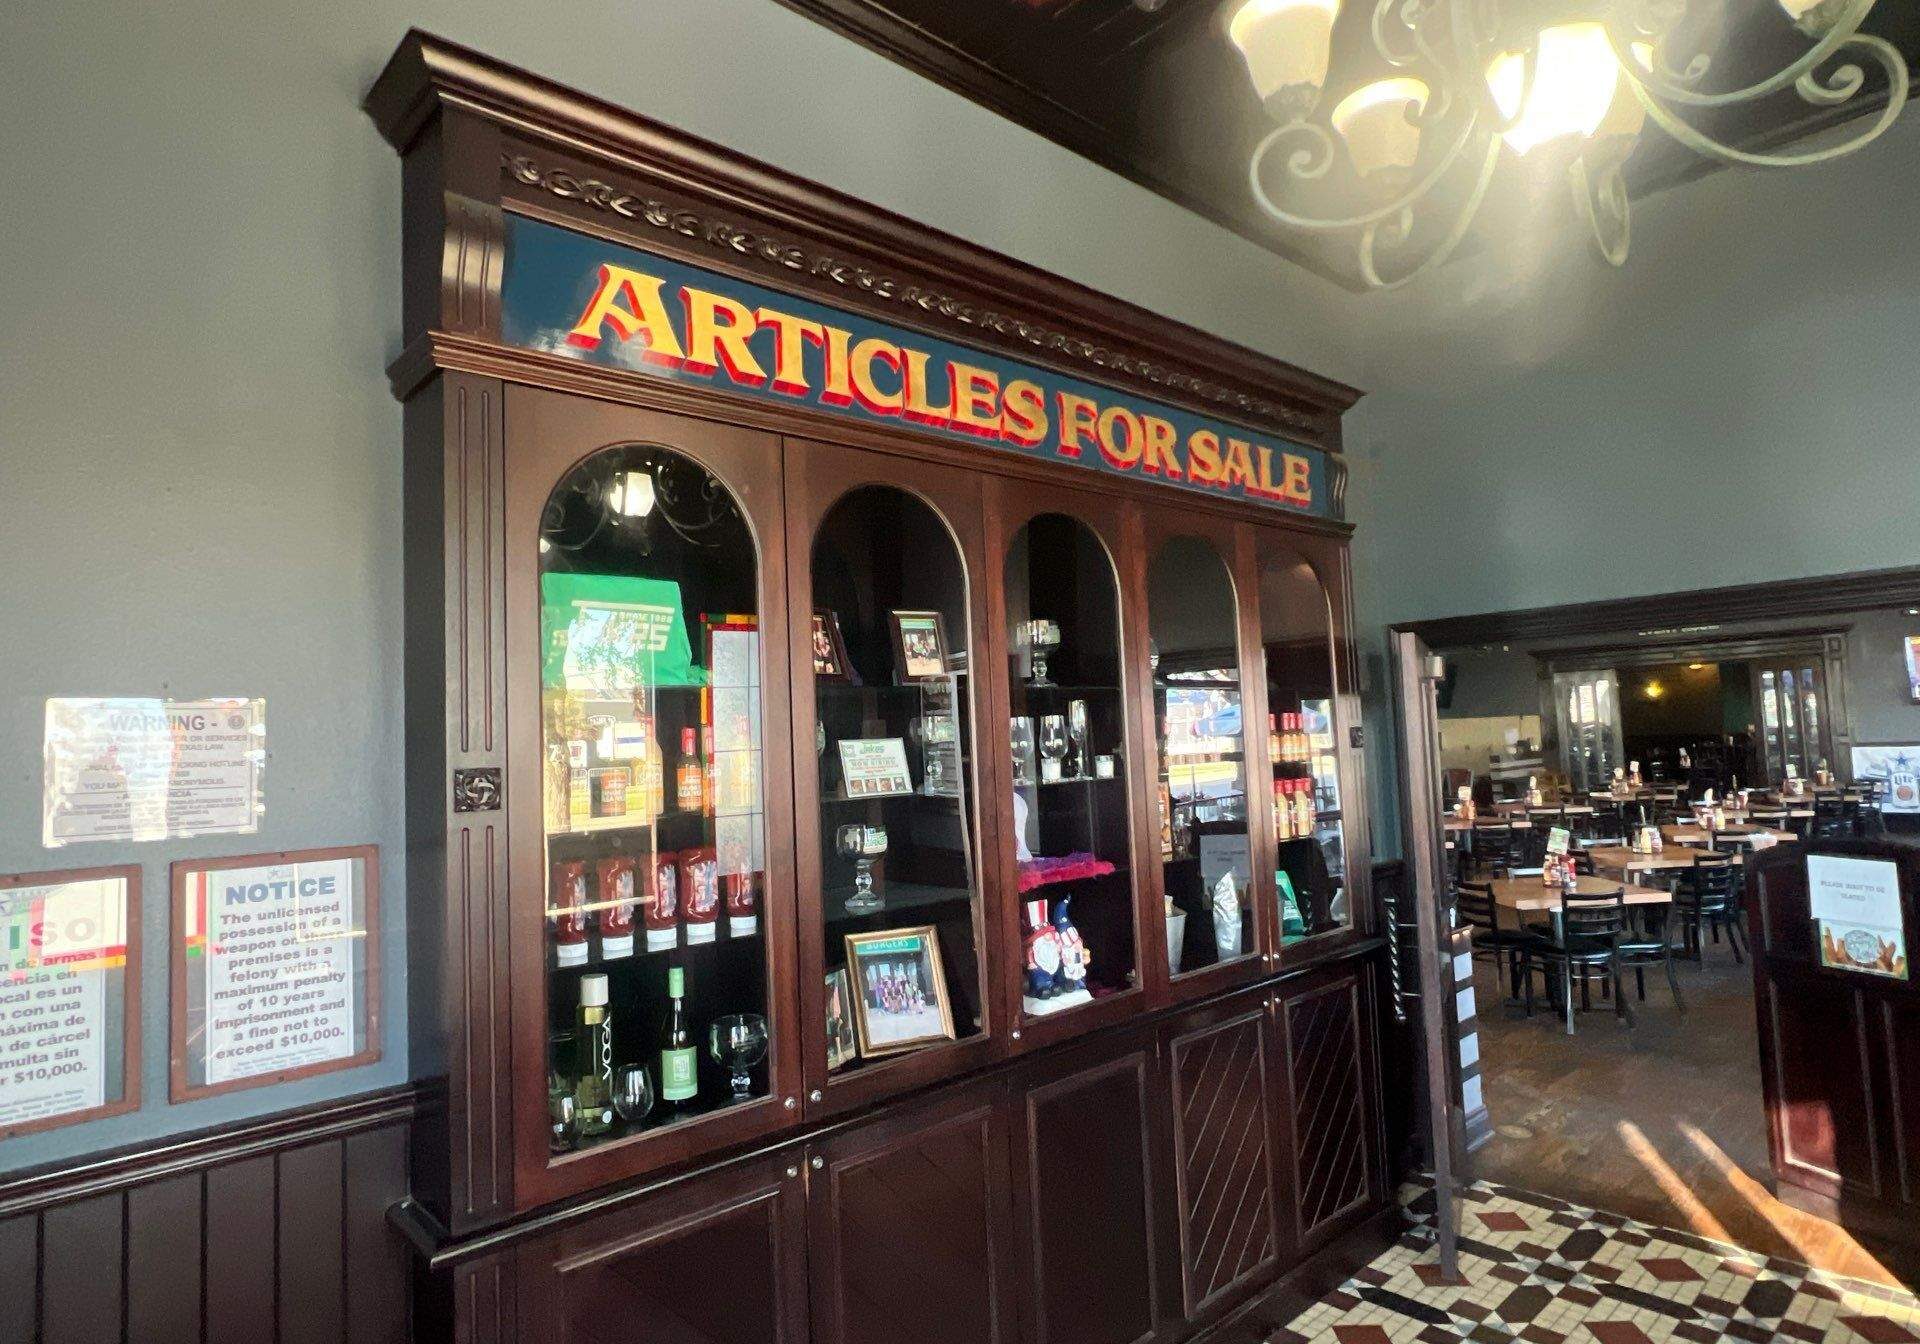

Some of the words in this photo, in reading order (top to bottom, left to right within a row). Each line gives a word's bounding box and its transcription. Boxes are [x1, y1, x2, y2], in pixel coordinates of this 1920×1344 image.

[565, 263, 1049, 448] ARTICLES
[1056, 391, 1182, 479] FOR
[1187, 429, 1312, 508] SALE
[110, 715, 205, 731] WARNING
[225, 876, 336, 906] NOTICE
[219, 922, 307, 942] possession
[312, 916, 327, 928] of
[332, 917, 341, 926] a
[220, 913, 251, 925] The
[215, 939, 276, 955] weapon
[281, 937, 299, 947] on
[228, 950, 301, 970] premises
[306, 945, 318, 956] is
[323, 946, 333, 955] a
[43, 951, 97, 967] armas
[56, 970, 78, 980] en
[230, 967, 279, 983] felony
[284, 960, 317, 976] with
[36, 988, 56, 999] es
[62, 985, 82, 995] un
[214, 980, 289, 1000] maximum
[294, 972, 346, 989] penalty
[12, 1006, 44, 1019] con
[50, 1001, 81, 1013] una
[237, 1000, 253, 1011] of
[260, 995, 279, 1007] 10
[283, 989, 325, 1006] years
[65, 1015, 85, 1026] de
[214, 1002, 315, 1030] imprisonment
[319, 998, 345, 1012] and
[10, 1041, 31, 1052] de
[36, 1028, 91, 1047] cárcel
[233, 1032, 243, 1042] a
[249, 1026, 279, 1039] fine
[284, 1018, 309, 1032] not
[314, 1016, 328, 1027] to
[55, 1047, 79, 1061] sin
[216, 1039, 274, 1060] exceed
[280, 1027, 345, 1049] $10,000.
[602, 1012, 612, 1080] VOGA
[14, 1061, 88, 1084] $10,000.
